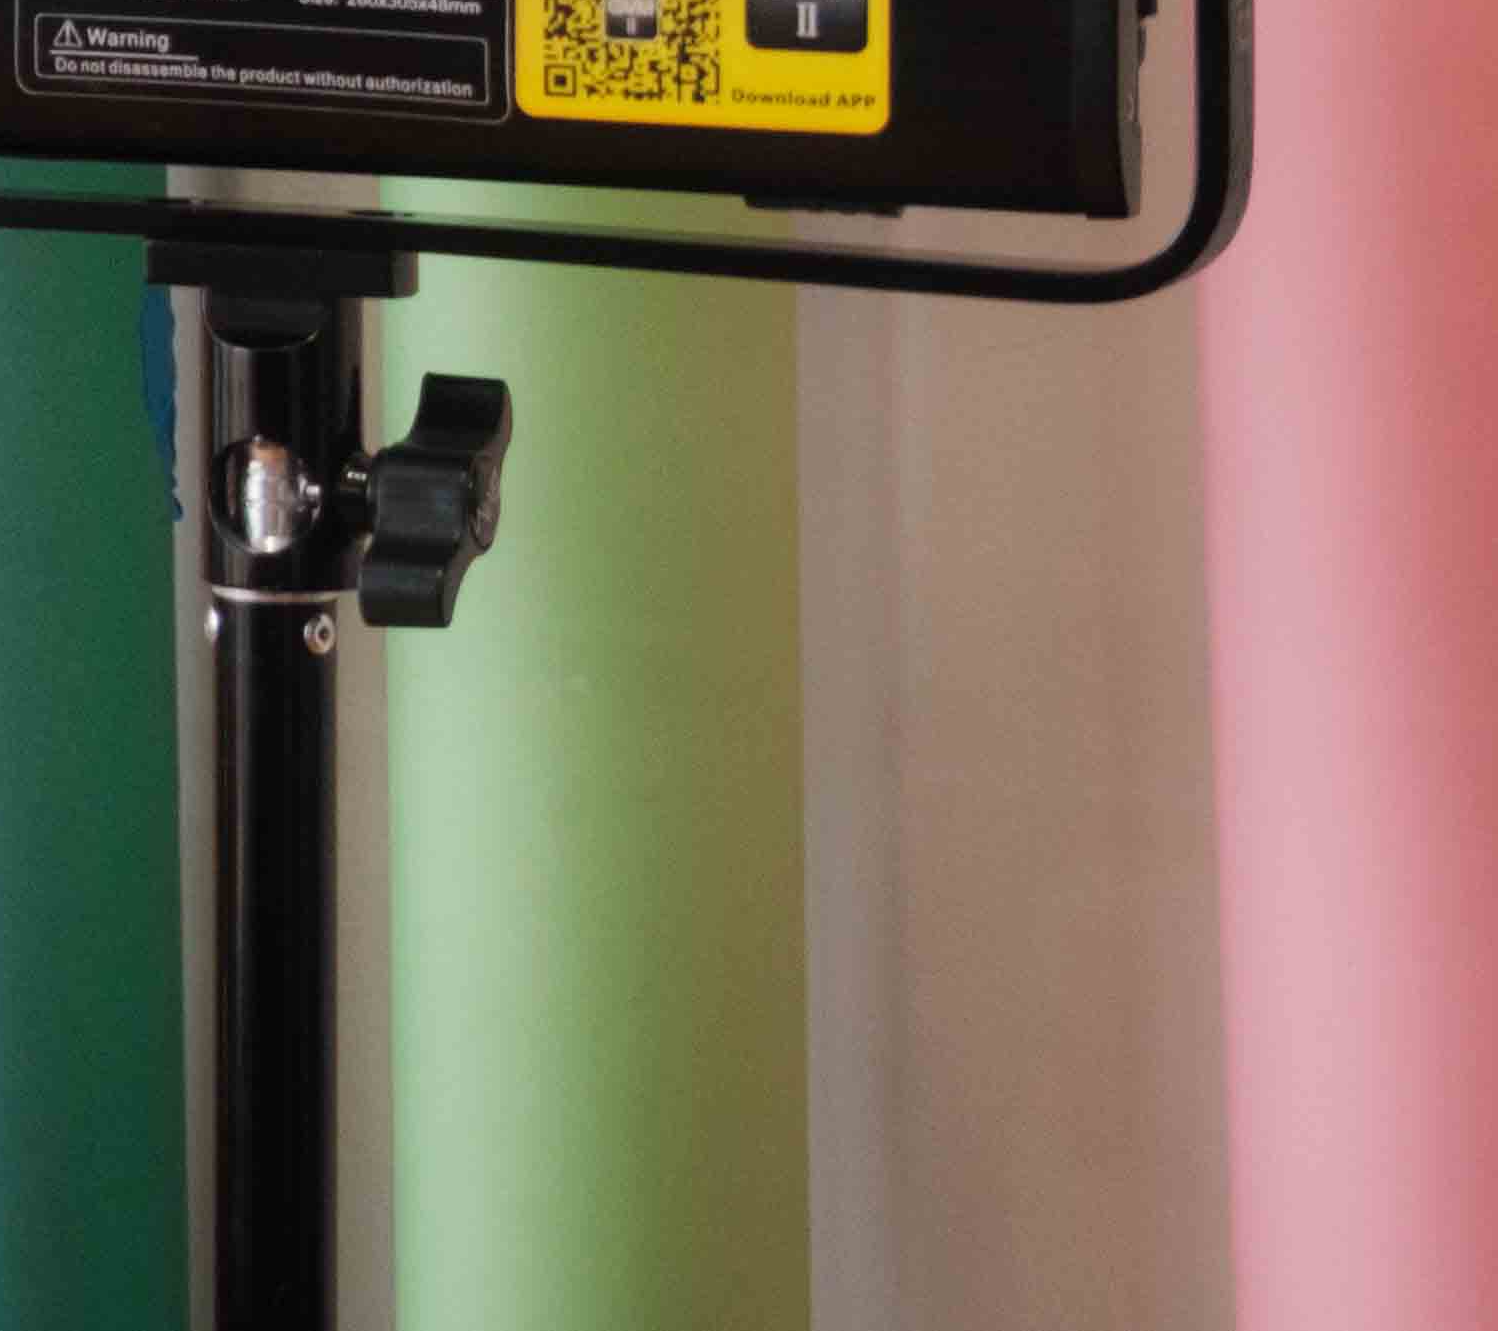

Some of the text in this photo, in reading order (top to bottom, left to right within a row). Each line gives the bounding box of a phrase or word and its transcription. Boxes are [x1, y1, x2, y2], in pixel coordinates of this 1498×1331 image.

[87, 26, 170, 53] Warning
[54, 56, 473, 96] Do not disassemble the product without authorization
[731, 89, 876, 108] Download APP
